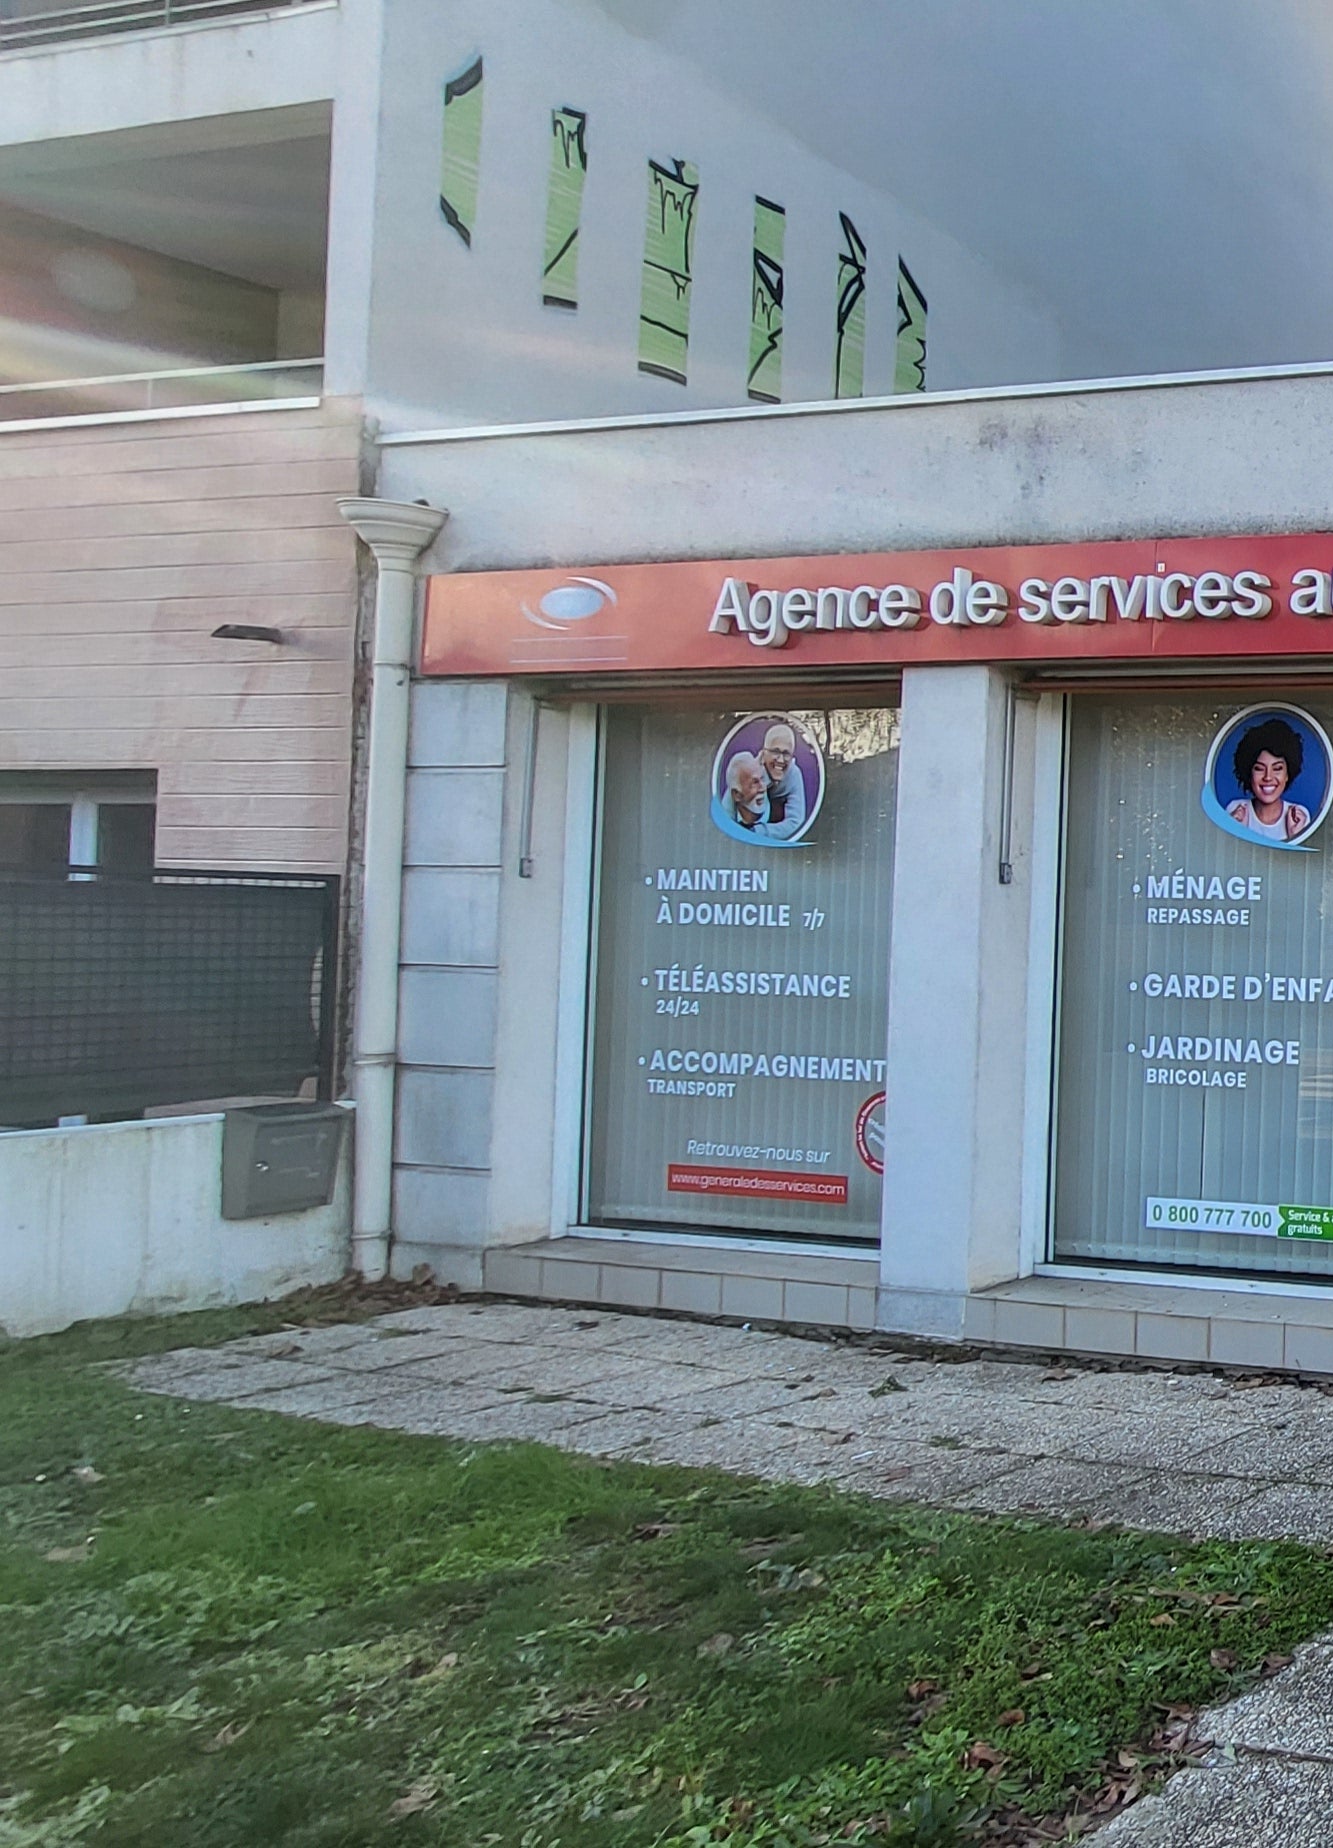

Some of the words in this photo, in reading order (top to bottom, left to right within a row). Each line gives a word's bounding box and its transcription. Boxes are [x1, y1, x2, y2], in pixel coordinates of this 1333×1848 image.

[708, 576, 921, 648] Agence
[930, 567, 1008, 626] de
[1017, 568, 1272, 623] services
[657, 869, 768, 892] MAINTIEN
[1147, 869, 1262, 900] MÉNAGE
[656, 896, 673, 924] À
[679, 902, 790, 927] DOMICILE
[802, 908, 825, 931] 7/7
[1147, 908, 1249, 926] REPASSAGE
[655, 964, 851, 998] TÉLÉASSISTANCE
[1143, 973, 1236, 999] GARDE
[656, 997, 699, 1017] 24/24
[1141, 1036, 1300, 1065] JARDINAGE
[650, 1050, 886, 1082] ACCOMPAGNEMENT
[648, 1079, 736, 1098] TRANSPORT
[1146, 1068, 1247, 1088] BRICOLAGE
[687, 1140, 803, 1162] Retrouvez-nous
[806, 1149, 830, 1164] sur
[671, 1173, 845, 1196] www.generaledesservices.com
[1153, 1205, 1162, 1222] 0
[1168, 1206, 1199, 1224] 800
[1204, 1208, 1235, 1226] 777
[1241, 1210, 1272, 1228] 700
[1287, 1210, 1321, 1223] Service
[1322, 1211, 1330, 1223] &
[1287, 1222, 1323, 1236] gratuits
